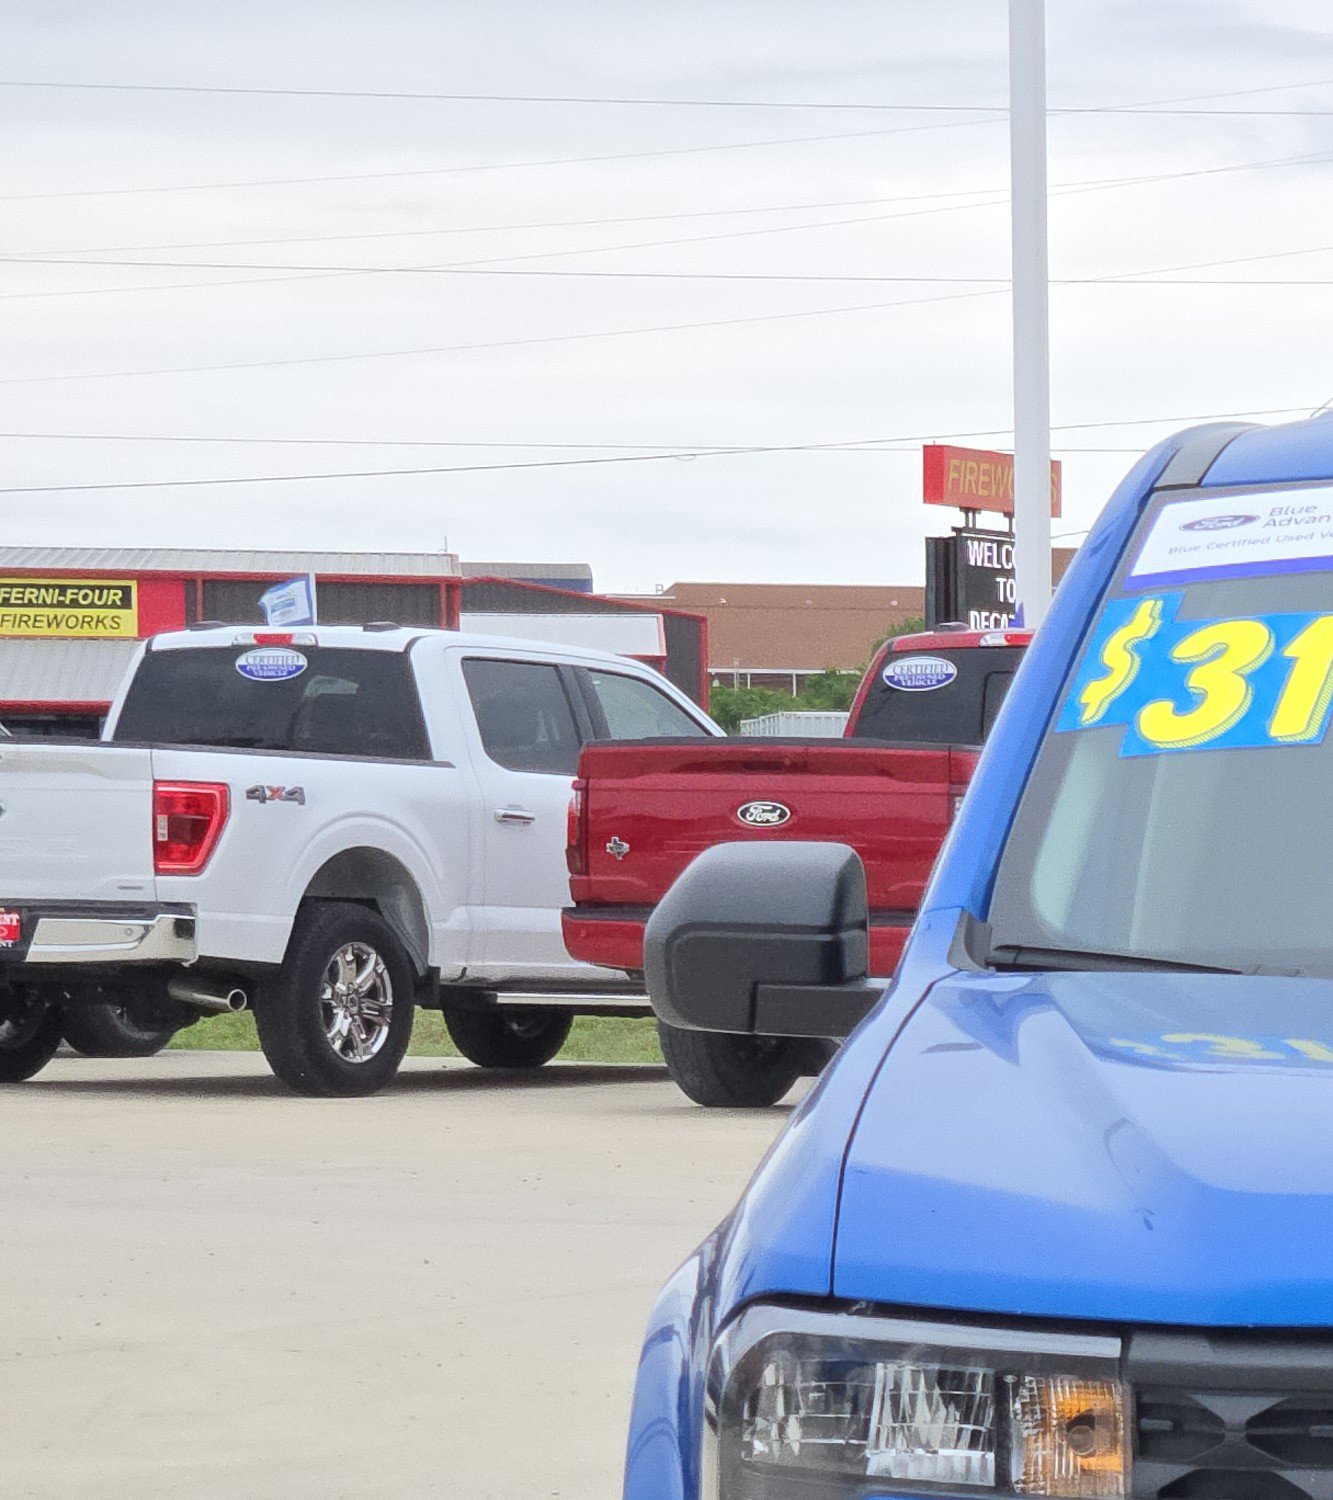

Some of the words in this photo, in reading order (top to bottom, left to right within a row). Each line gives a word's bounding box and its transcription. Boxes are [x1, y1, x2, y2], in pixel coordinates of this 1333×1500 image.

[1269, 504, 1318, 517] Blue
[995, 577, 1017, 604] TO
[0, 613, 122, 630] FIREWORKS
[969, 610, 1016, 630] DECA
